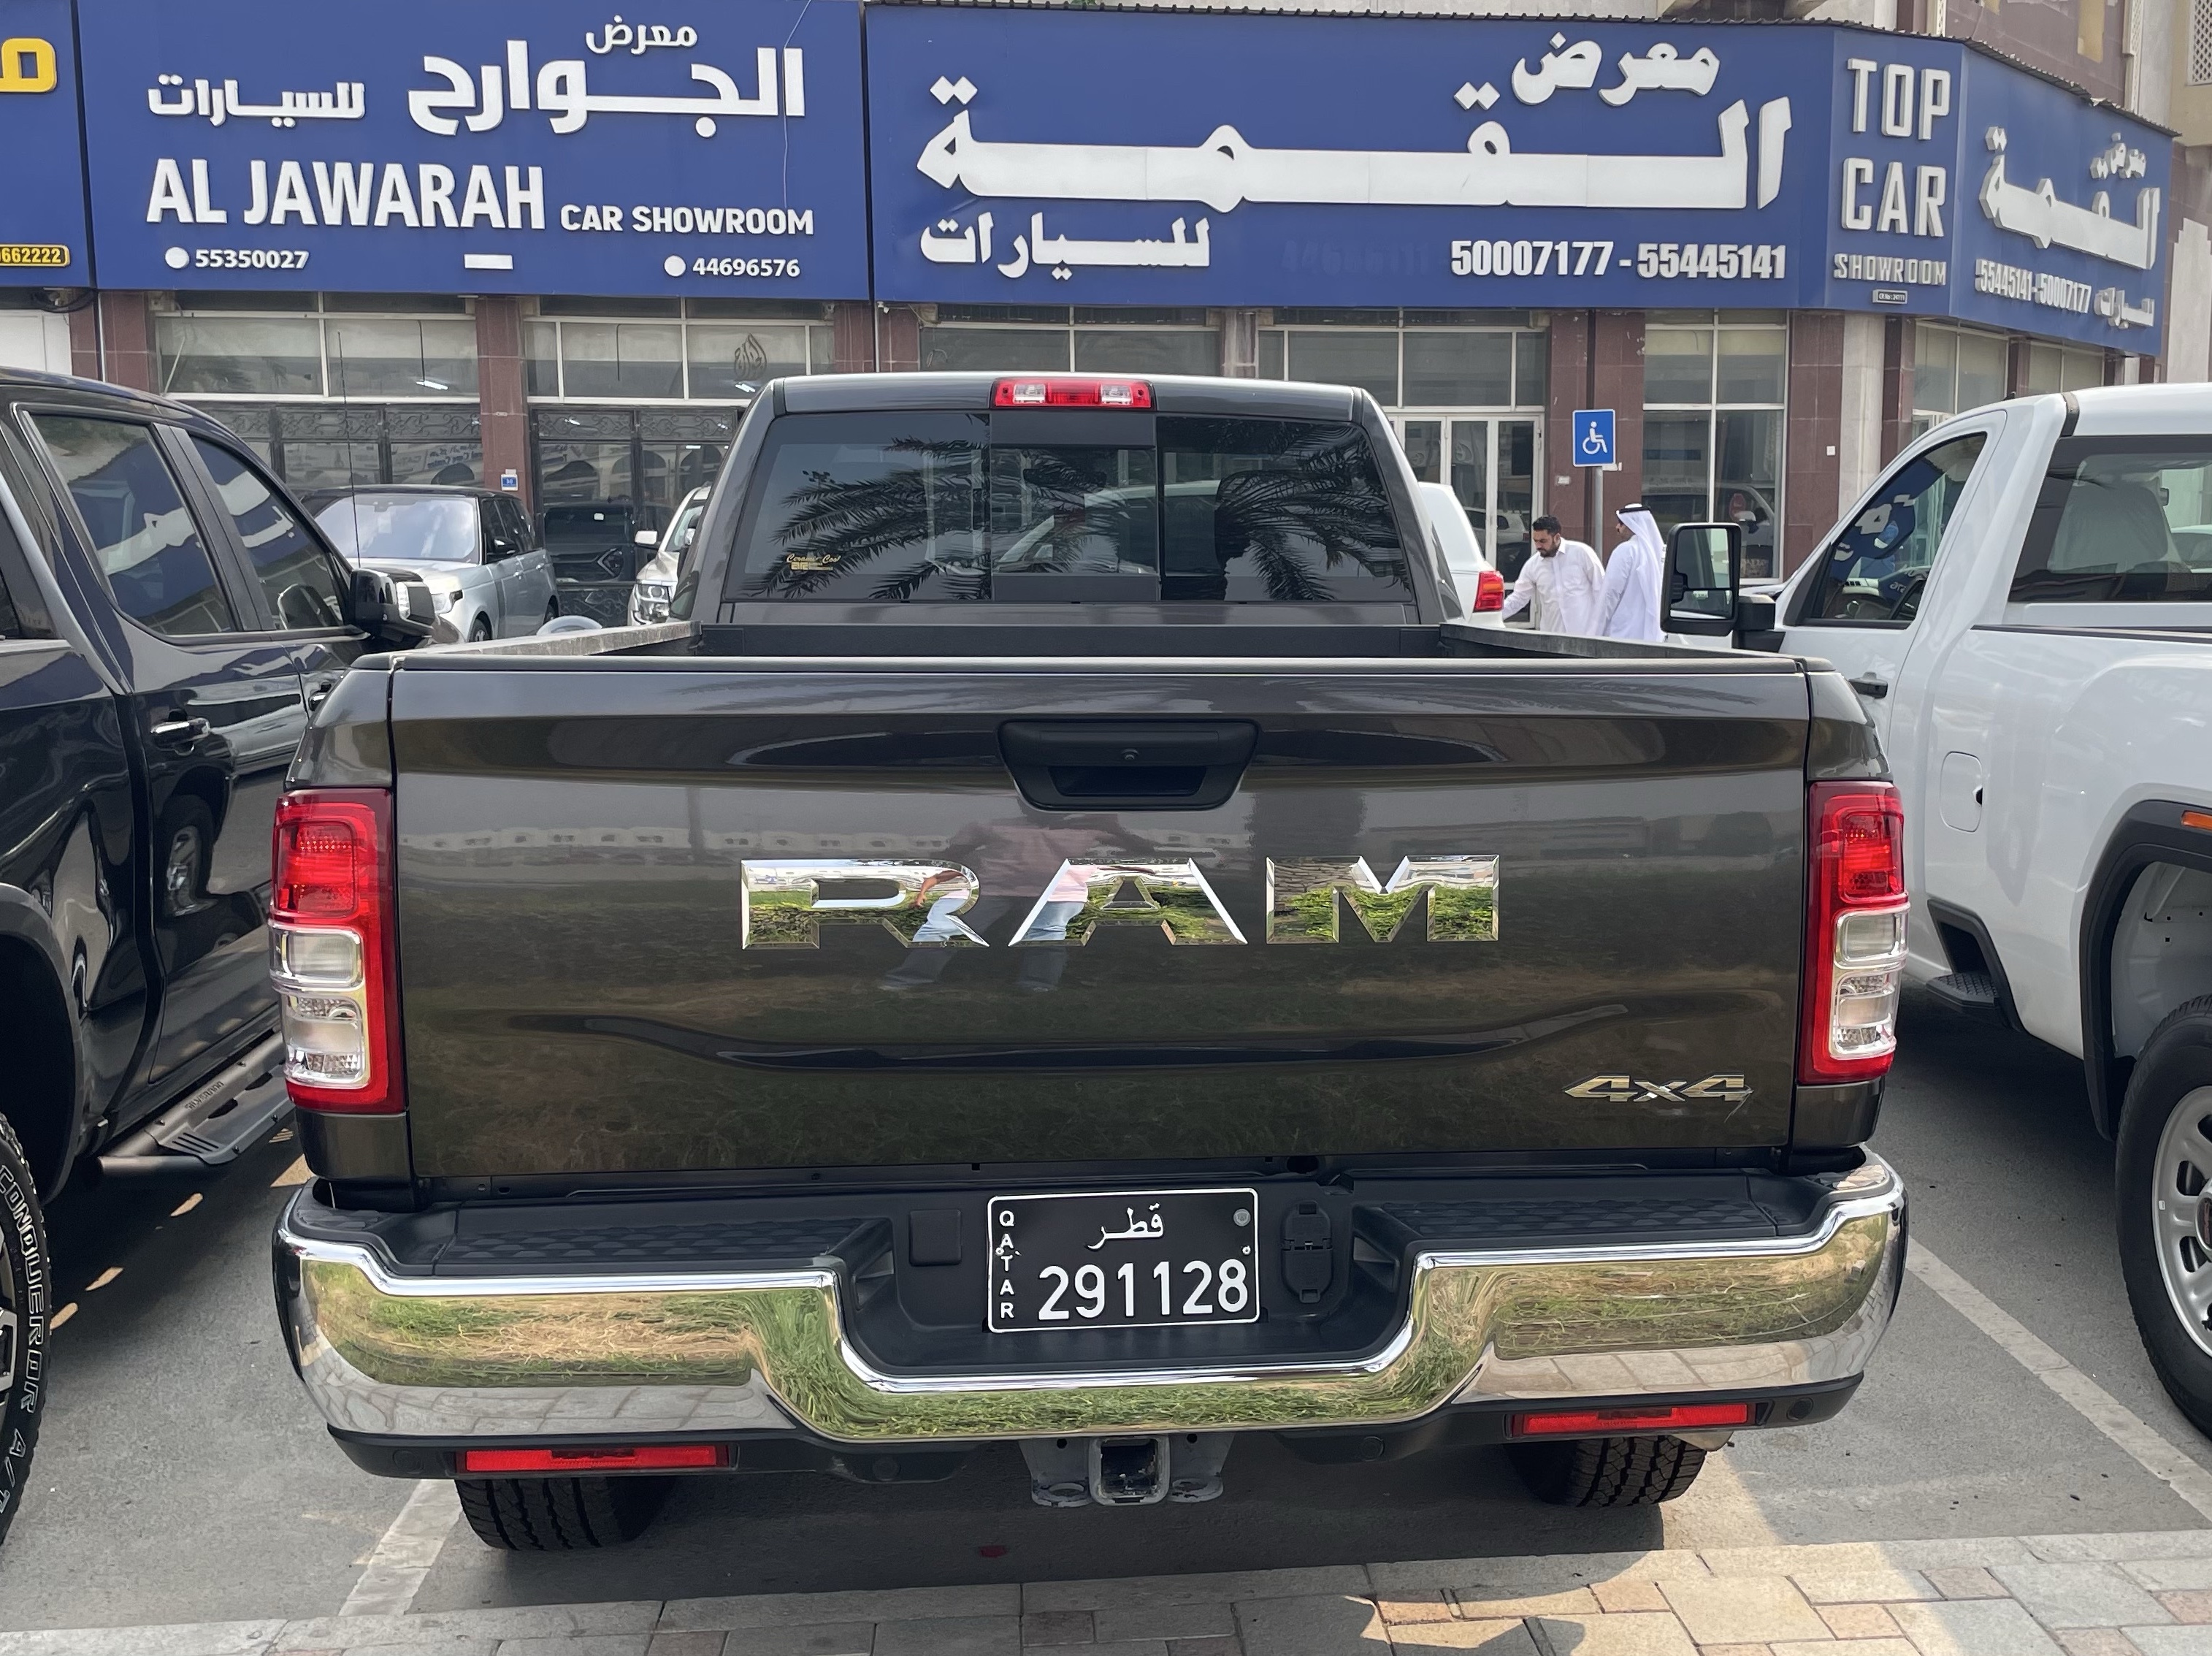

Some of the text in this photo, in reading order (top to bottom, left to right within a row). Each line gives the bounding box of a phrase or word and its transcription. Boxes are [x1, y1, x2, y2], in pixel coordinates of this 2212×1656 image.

[586, 15, 697, 55] معرض
[1512, 32, 1720, 105] معرض
[148, 39, 805, 137] الجوارح للسيارات
[1848, 58, 1951, 140] TOP
[917, 76, 1792, 213] القمة
[147, 159, 814, 235] AL JAWARAH CAR SHOWROOM
[1842, 158, 1946, 237] CAR
[1979, 126, 2160, 270] القمة
[0, 247, 61, 263] 662222
[196, 249, 309, 269] 55350027
[693, 258, 800, 277] 44696576
[921, 212, 1210, 281] للسيارات
[1451, 240, 1613, 275] 50007177
[1638, 243, 1786, 279] 55445141
[1834, 253, 1946, 286] SHOWROOM
[740, 854, 1500, 949] RAM
[1564, 1073, 1753, 1102] 4x4
[1086, 1202, 1164, 1250] قطر
[0, 1164, 45, 1415] CONQUEROR
[998, 1210, 1014, 1319] QATAR
[1038, 1259, 1248, 1321] 291128
